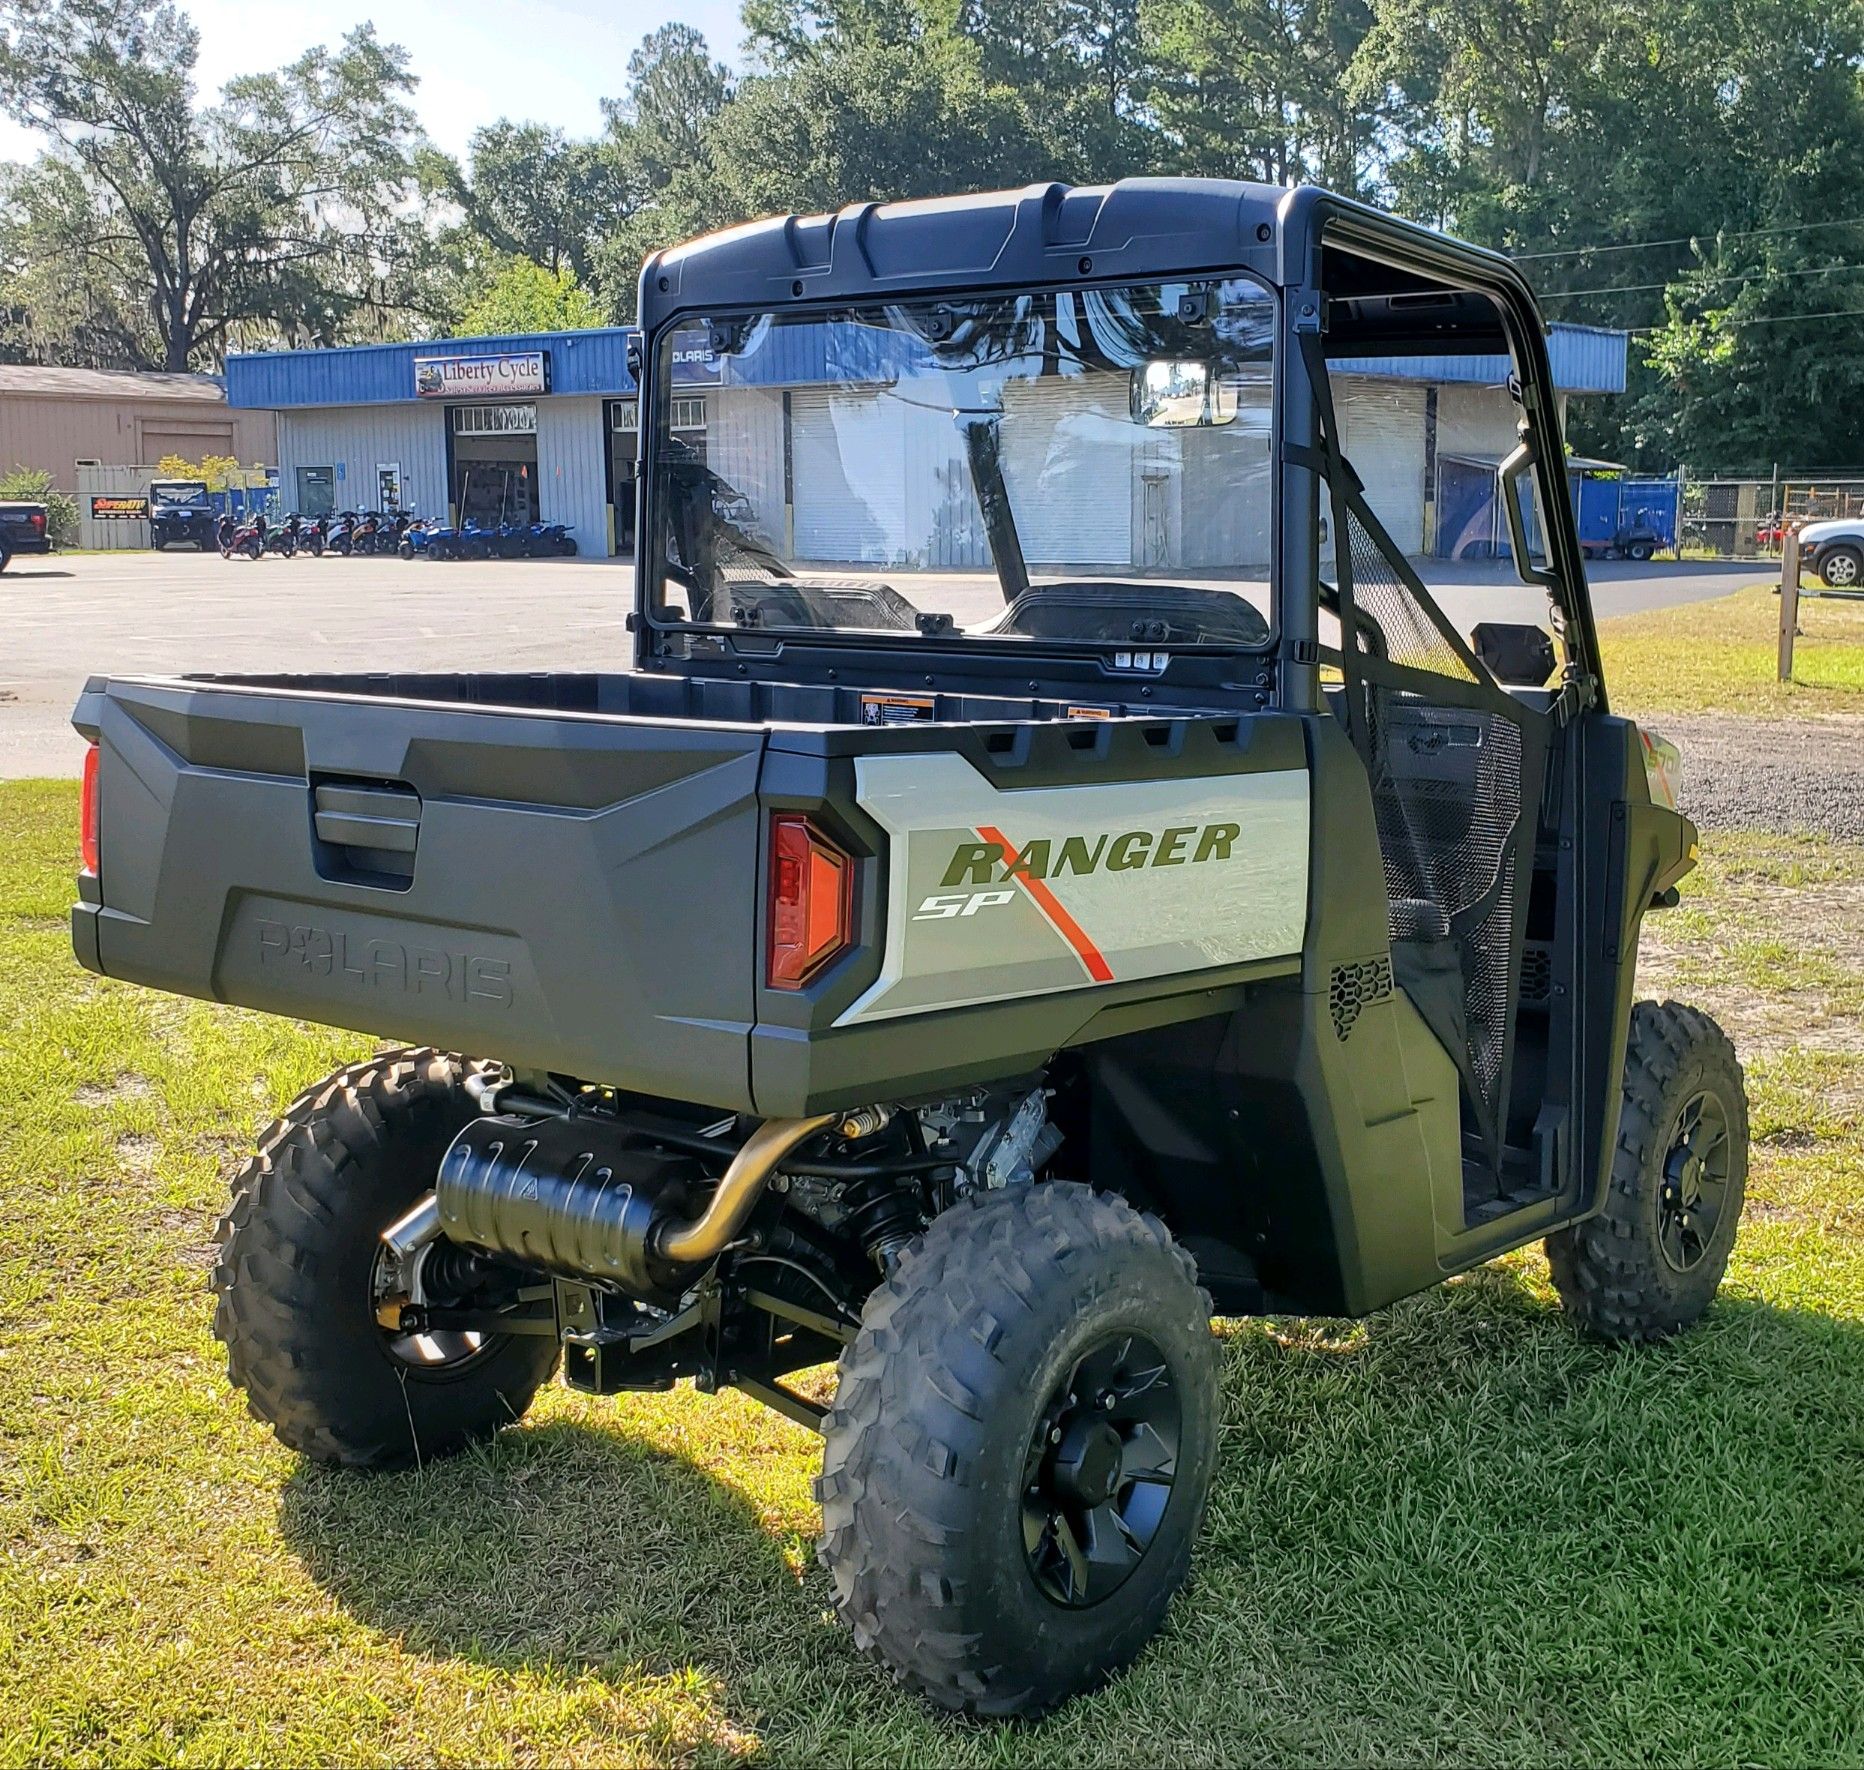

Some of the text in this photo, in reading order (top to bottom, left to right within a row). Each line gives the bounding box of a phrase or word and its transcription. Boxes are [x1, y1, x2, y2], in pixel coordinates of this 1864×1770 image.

[443, 357, 539, 385] Liberty Cycle
[673, 350, 713, 363] OLARIS
[940, 823, 1240, 887] RANGER
[912, 890, 1016, 921] SP
[255, 917, 514, 1010] POLARIS
